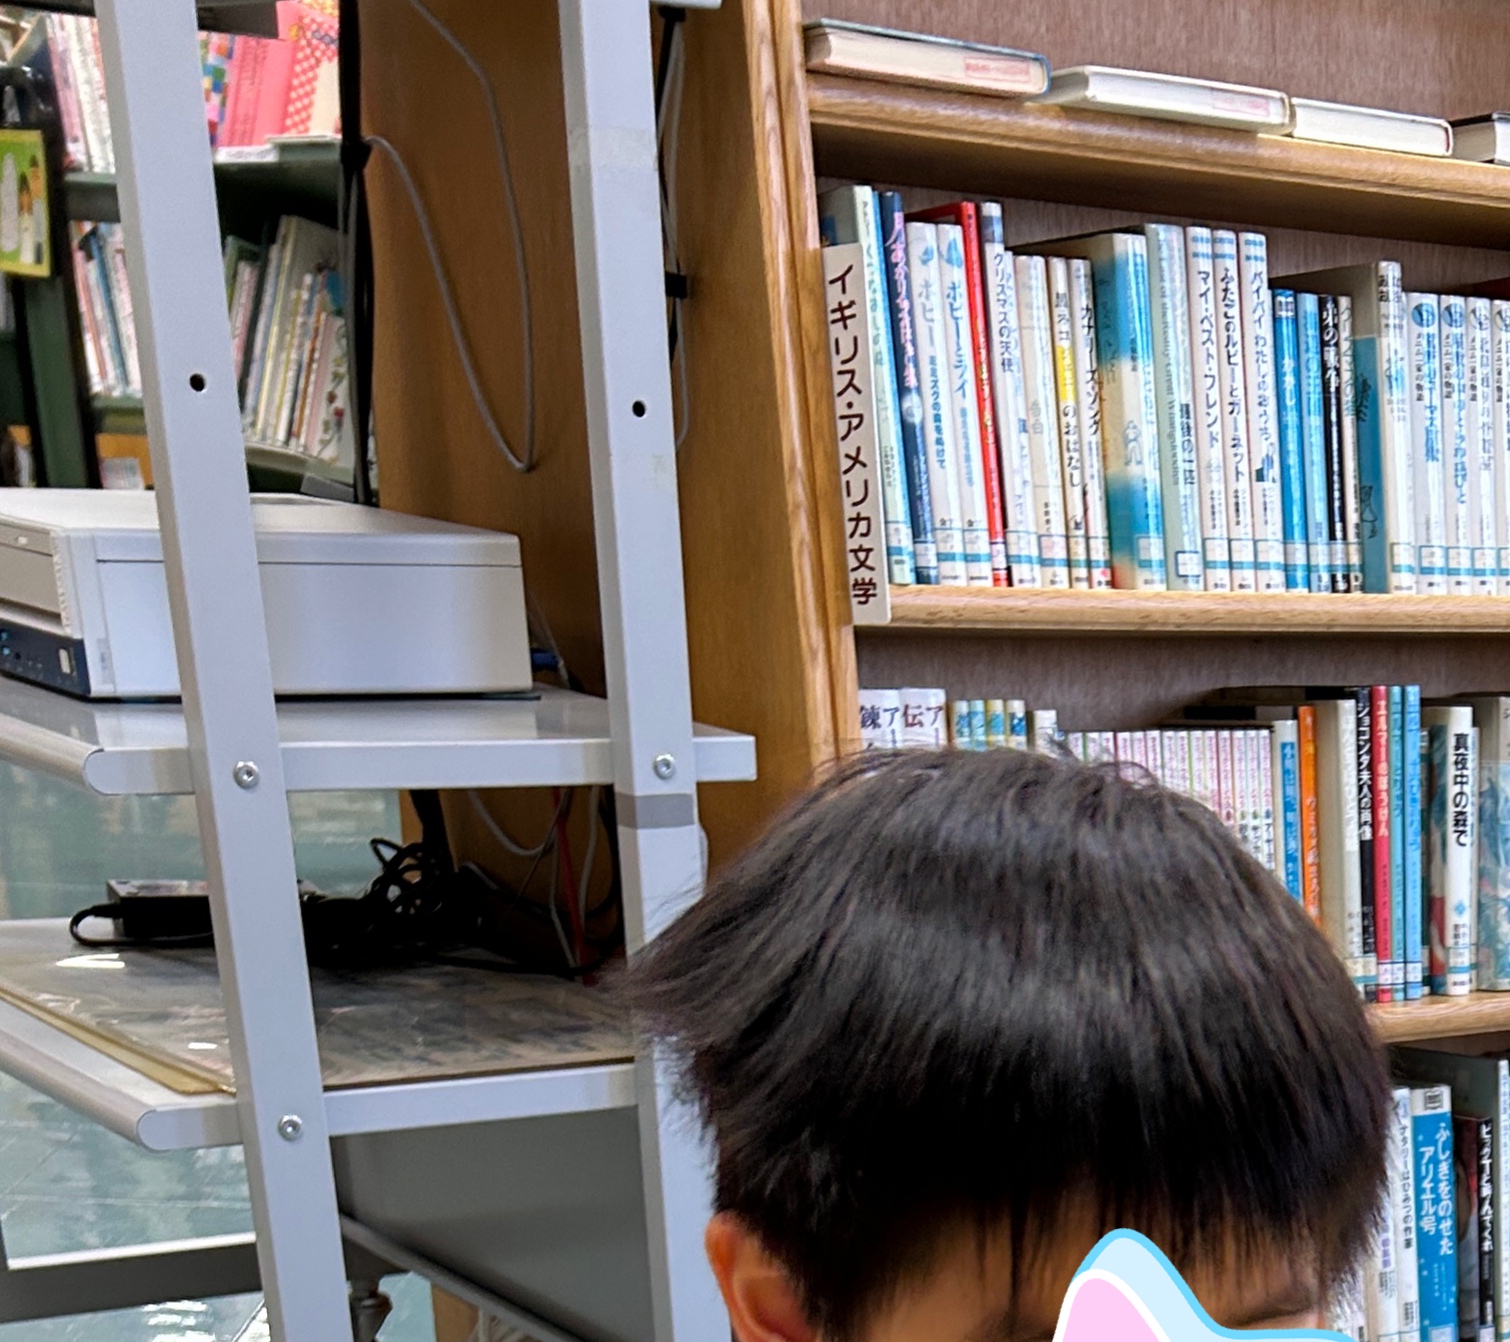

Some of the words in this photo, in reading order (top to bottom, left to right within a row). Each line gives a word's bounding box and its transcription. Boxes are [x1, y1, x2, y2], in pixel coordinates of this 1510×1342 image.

[993, 252, 1014, 372] クリスマスの天使
[1197, 270, 1221, 448] マイ・ベスト・フレンド
[1322, 297, 1340, 393] 弟の戦争
[828, 264, 877, 605] イギリス・アメリカ文学
[1357, 701, 1373, 841] ジョコンダ夫人の肖像
[1377, 701, 1389, 837] エルマーのぼうけん
[1419, 1146, 1437, 1235] アリエル号
[1435, 1122, 1454, 1256] ふしぎをのせた
